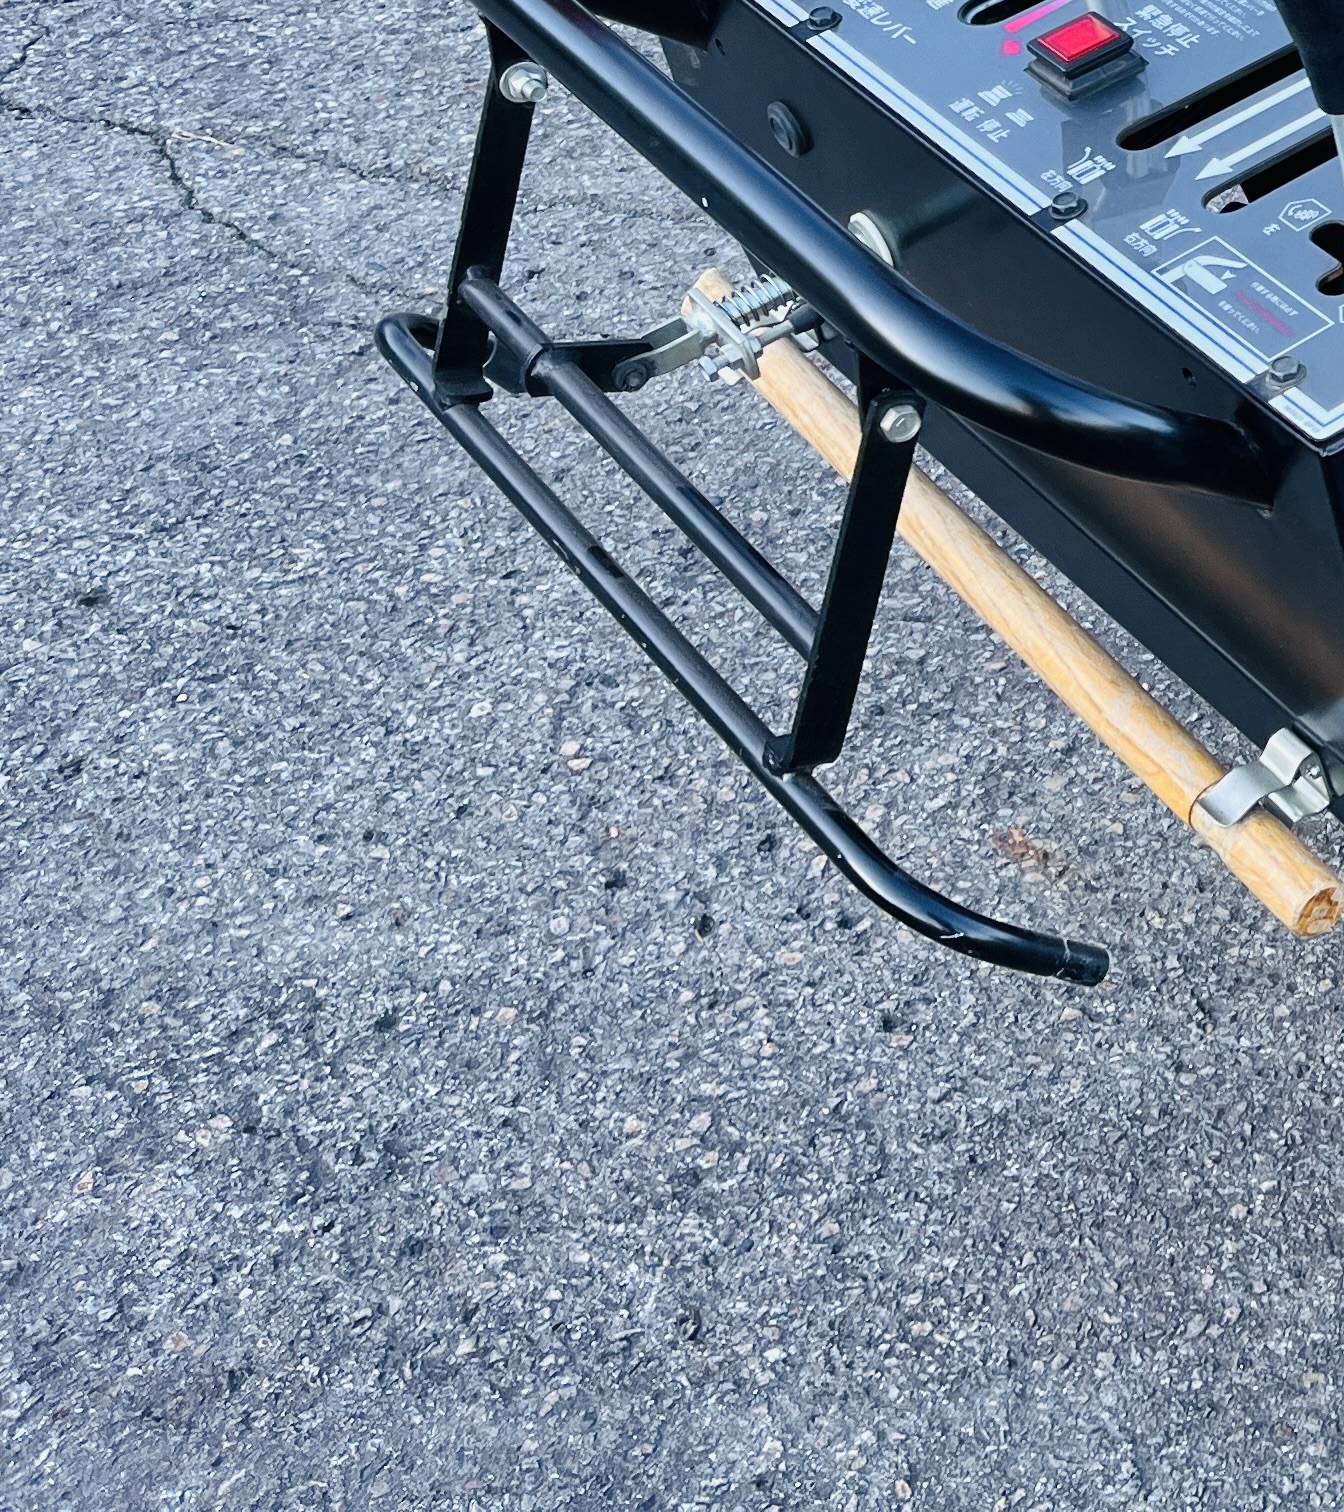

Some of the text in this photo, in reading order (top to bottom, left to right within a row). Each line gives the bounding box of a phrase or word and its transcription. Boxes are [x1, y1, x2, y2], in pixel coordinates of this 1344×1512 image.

[1113, 16, 1180, 56] スイッチ
[1134, 4, 1200, 49] 緊急停止
[1123, 231, 1158, 257] 右方向
